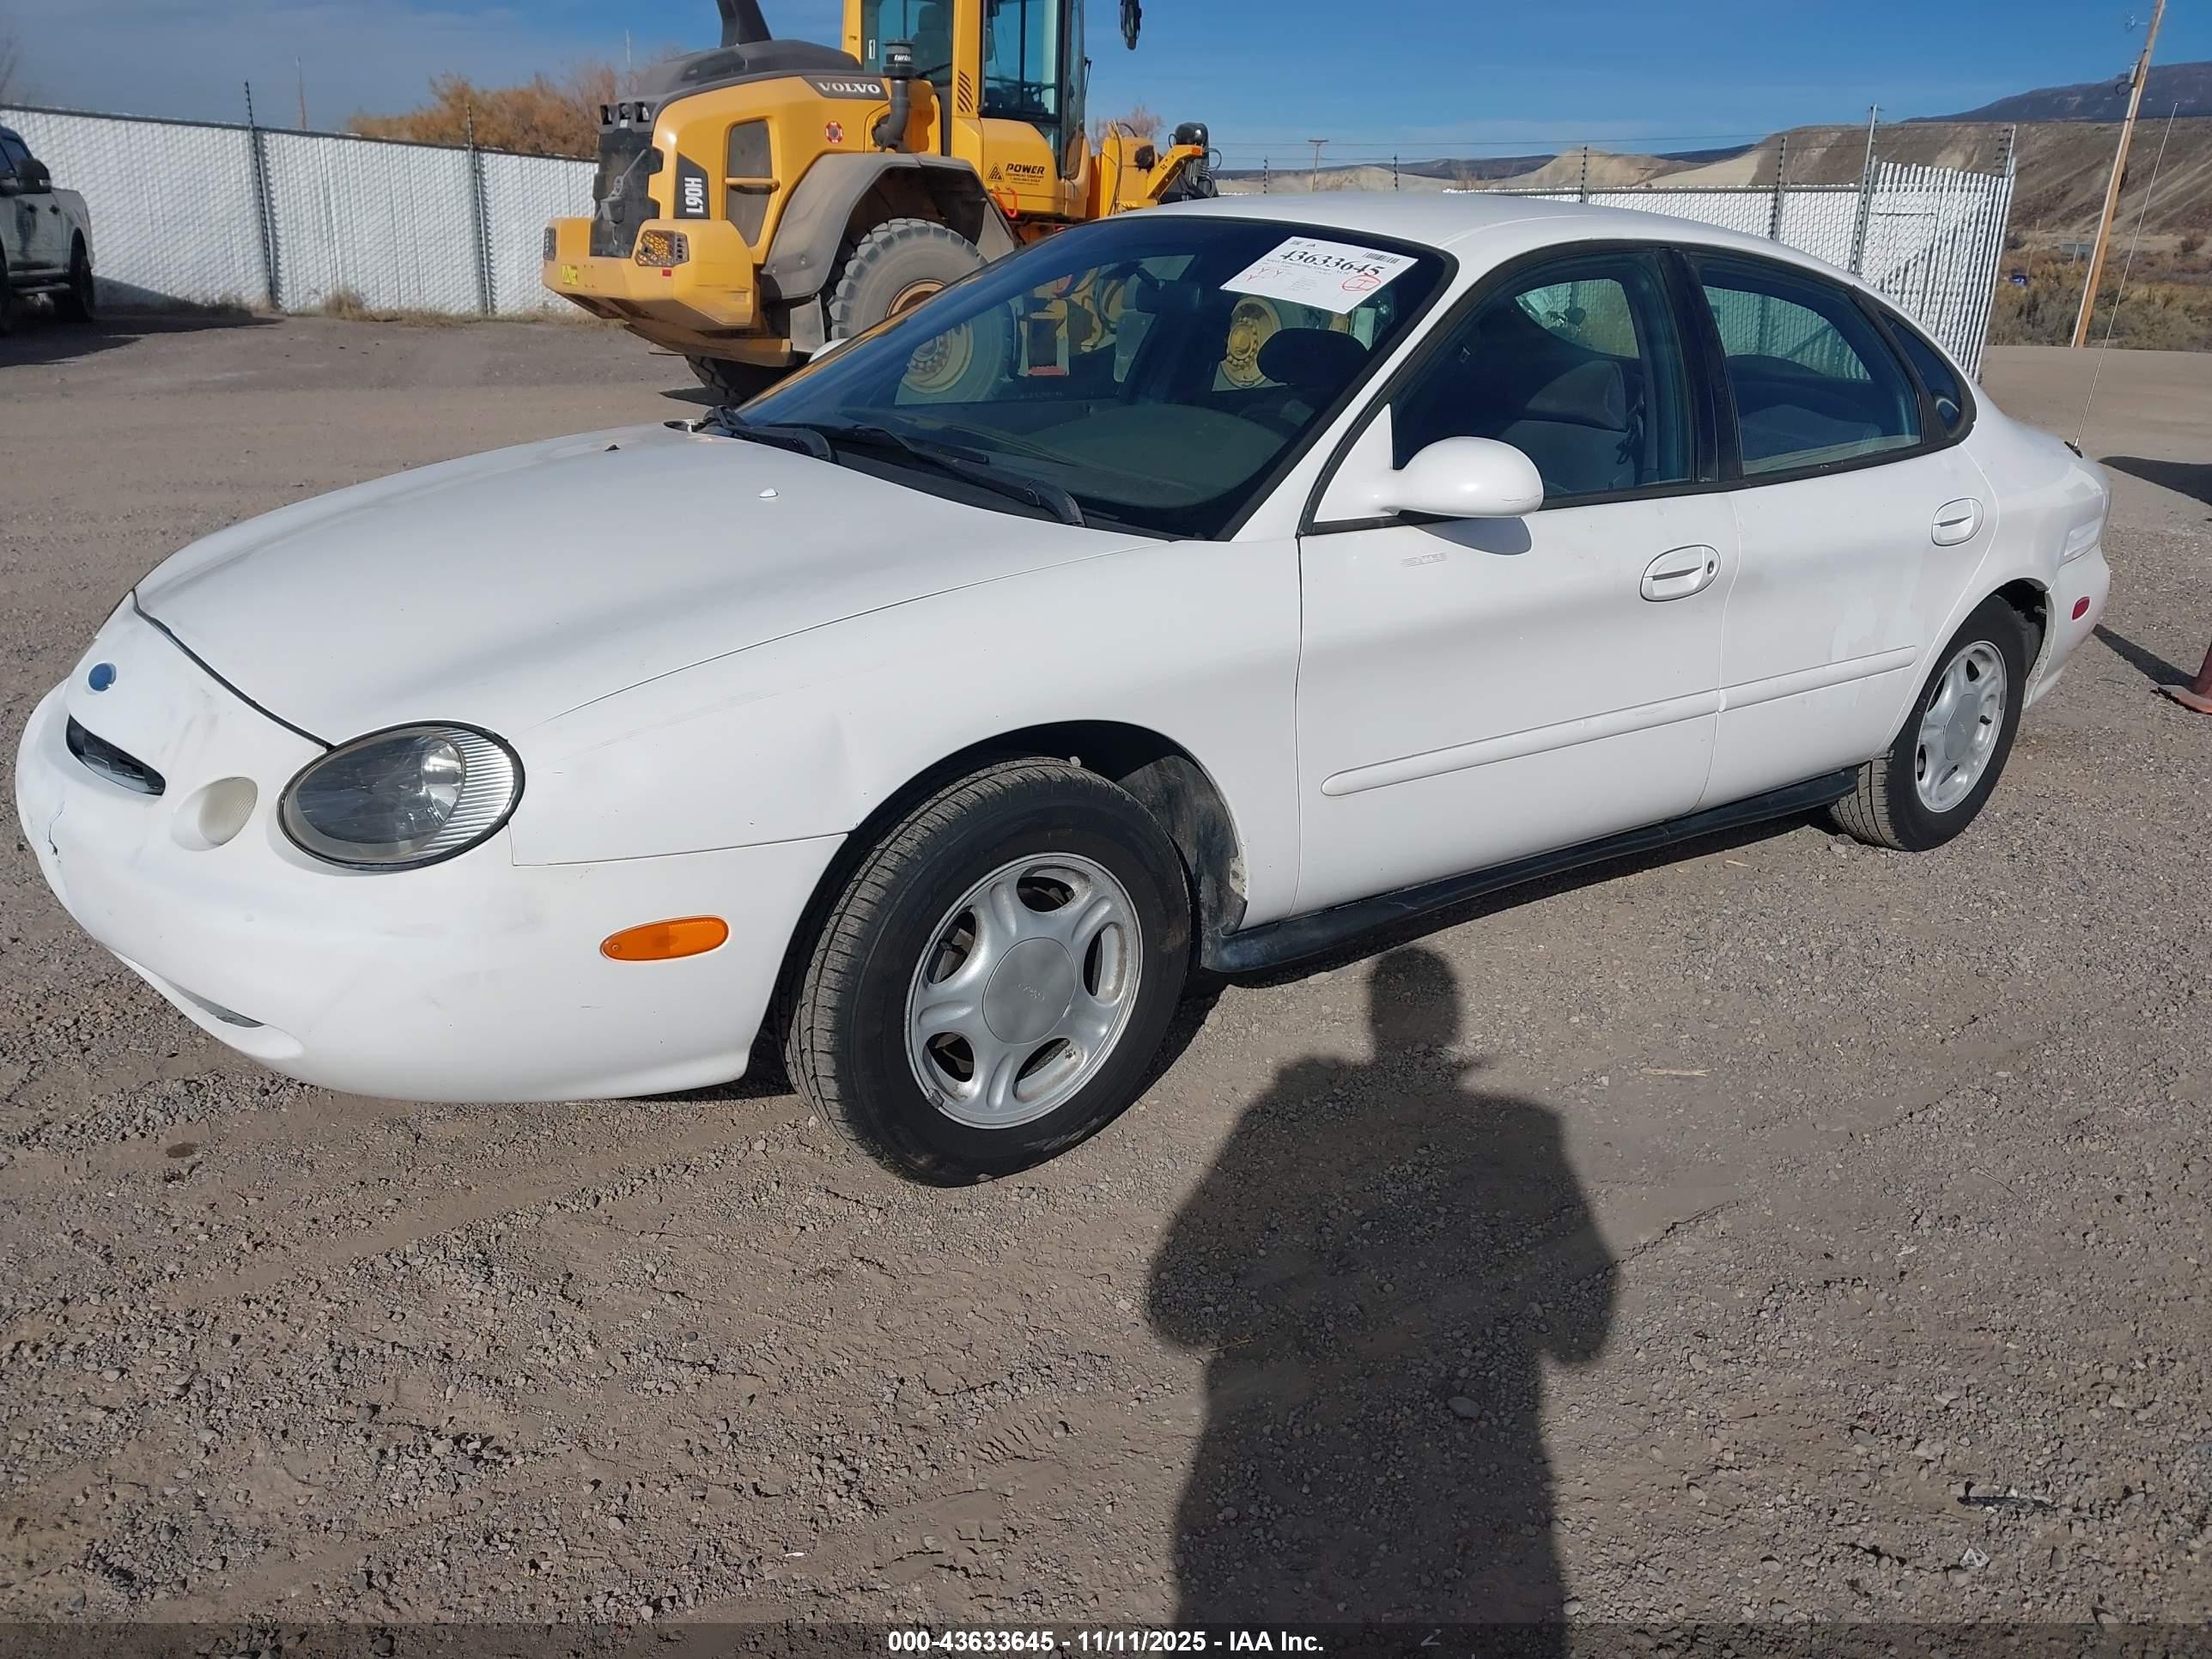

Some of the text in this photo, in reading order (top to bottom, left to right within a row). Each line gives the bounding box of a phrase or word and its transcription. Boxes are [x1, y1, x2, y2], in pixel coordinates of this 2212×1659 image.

[817, 82, 880, 94] VOLVO
[1006, 163, 1045, 174] POWER
[684, 177, 703, 213] L90H
[1279, 250, 1386, 276] 43633645
